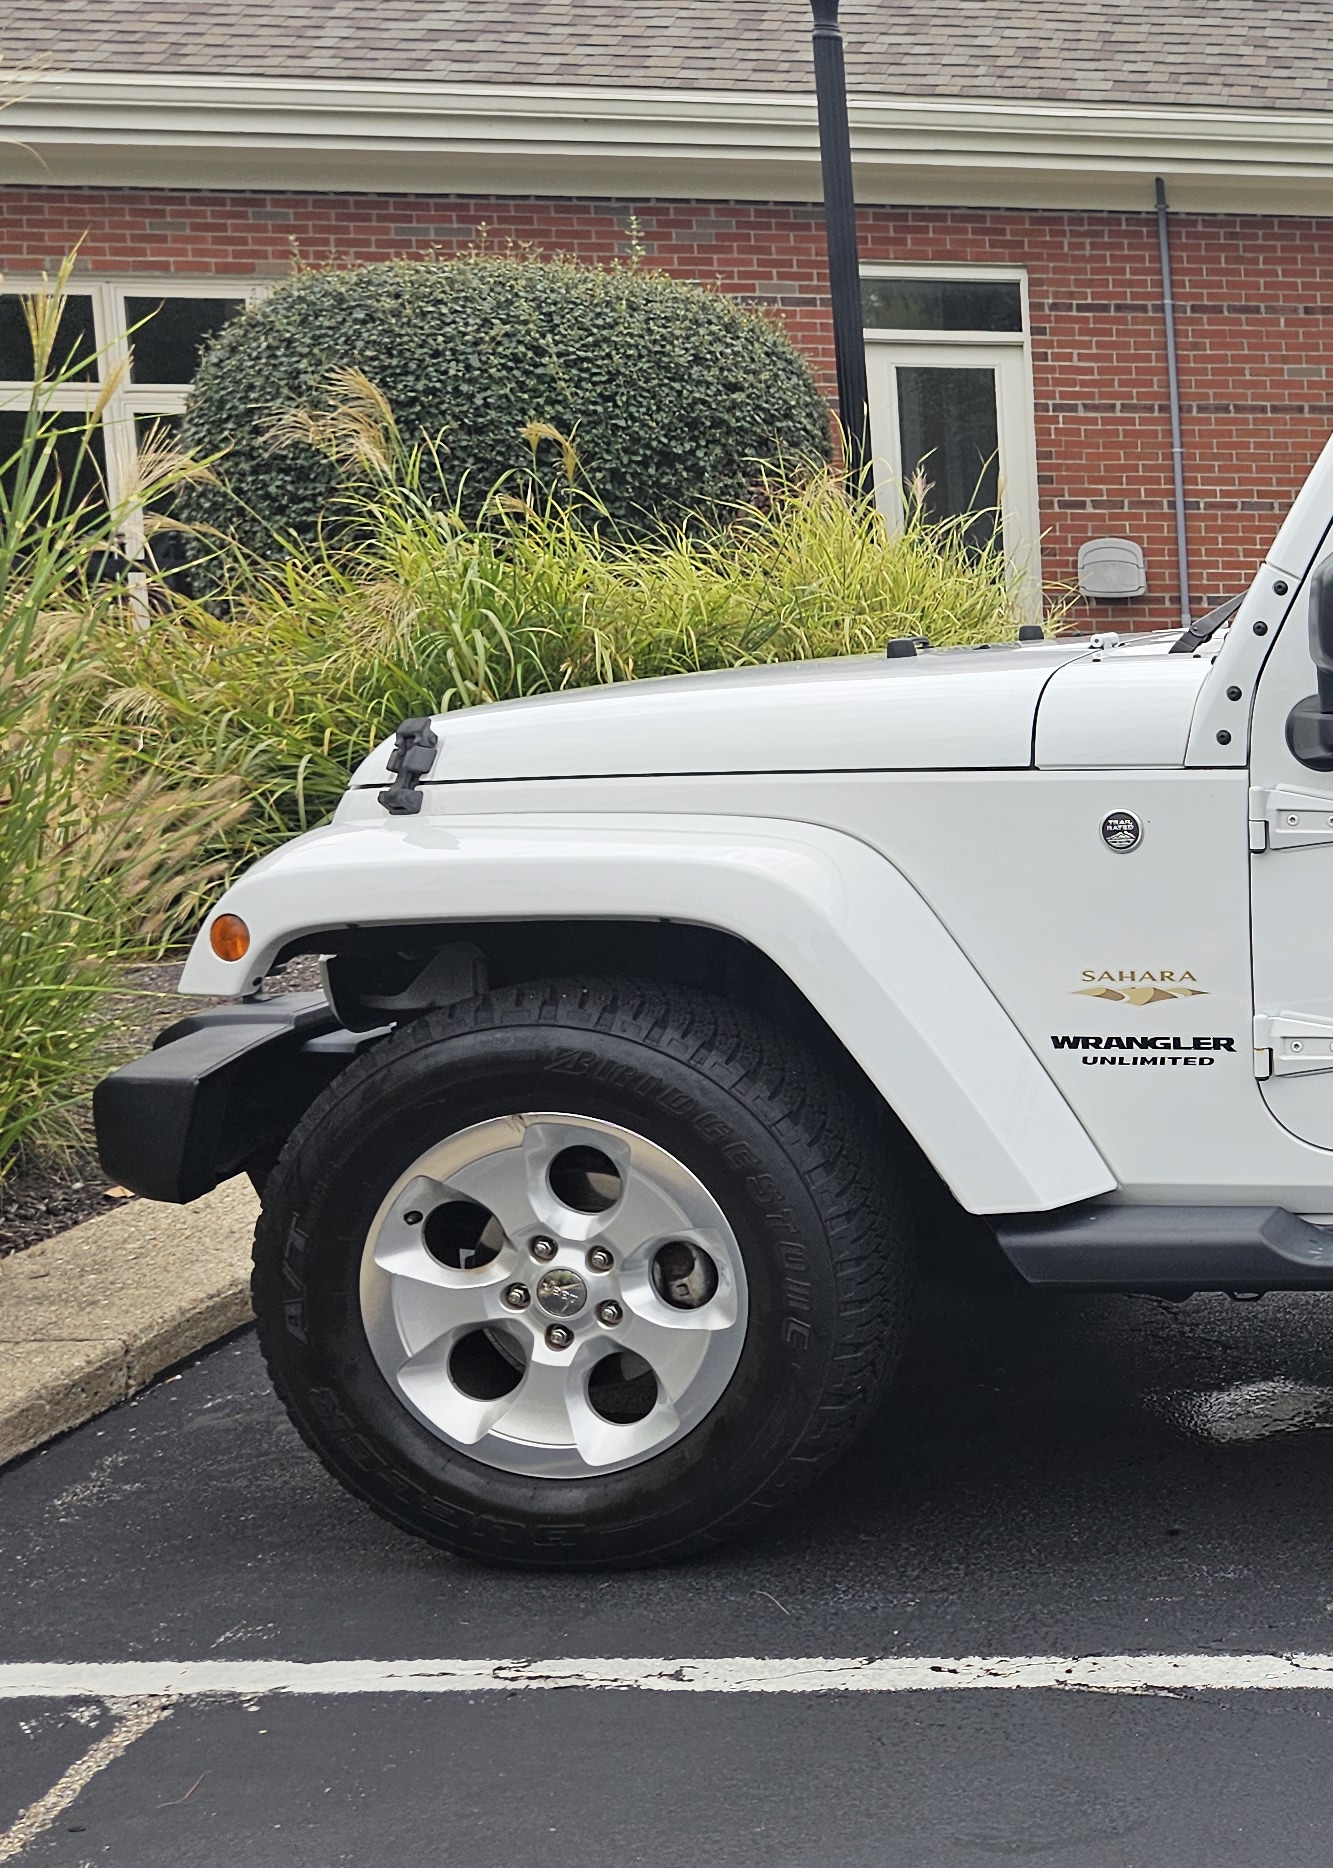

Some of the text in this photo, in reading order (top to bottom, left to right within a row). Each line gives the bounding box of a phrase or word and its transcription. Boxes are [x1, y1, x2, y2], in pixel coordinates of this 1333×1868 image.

[1081, 969, 1198, 983] SAHARA
[1050, 1035, 1237, 1053] WRANGLER
[1081, 1056, 1215, 1067] UNLIMITED
